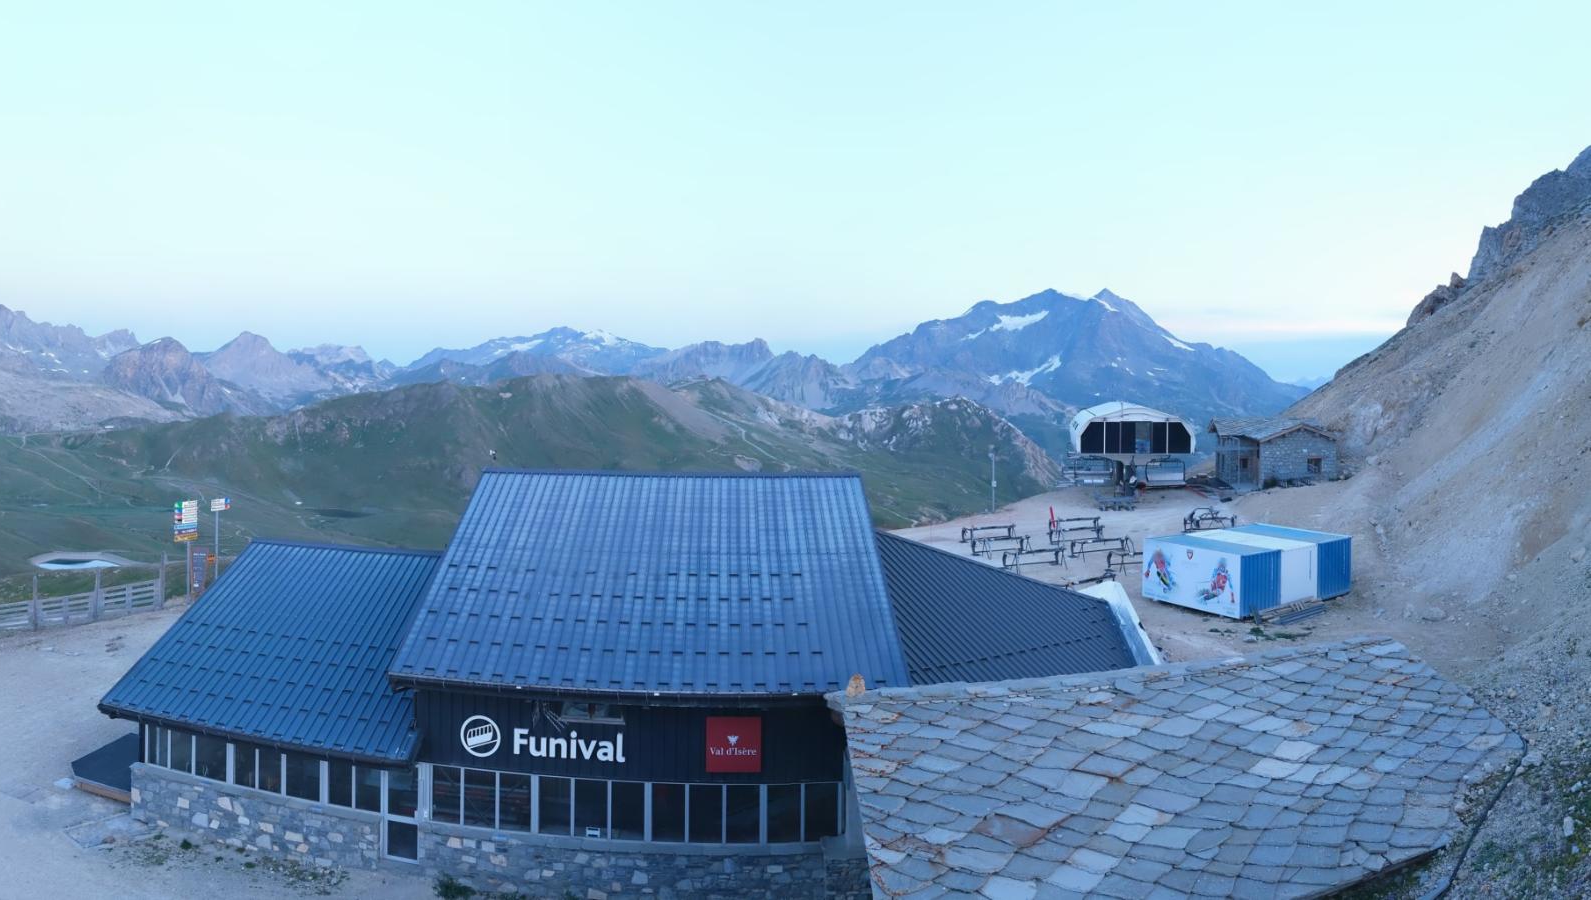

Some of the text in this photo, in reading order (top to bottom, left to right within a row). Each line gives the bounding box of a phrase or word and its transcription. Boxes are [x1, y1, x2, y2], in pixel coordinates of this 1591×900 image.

[513, 728, 626, 763] Funival
[710, 747, 757, 756] Val d'Isère
